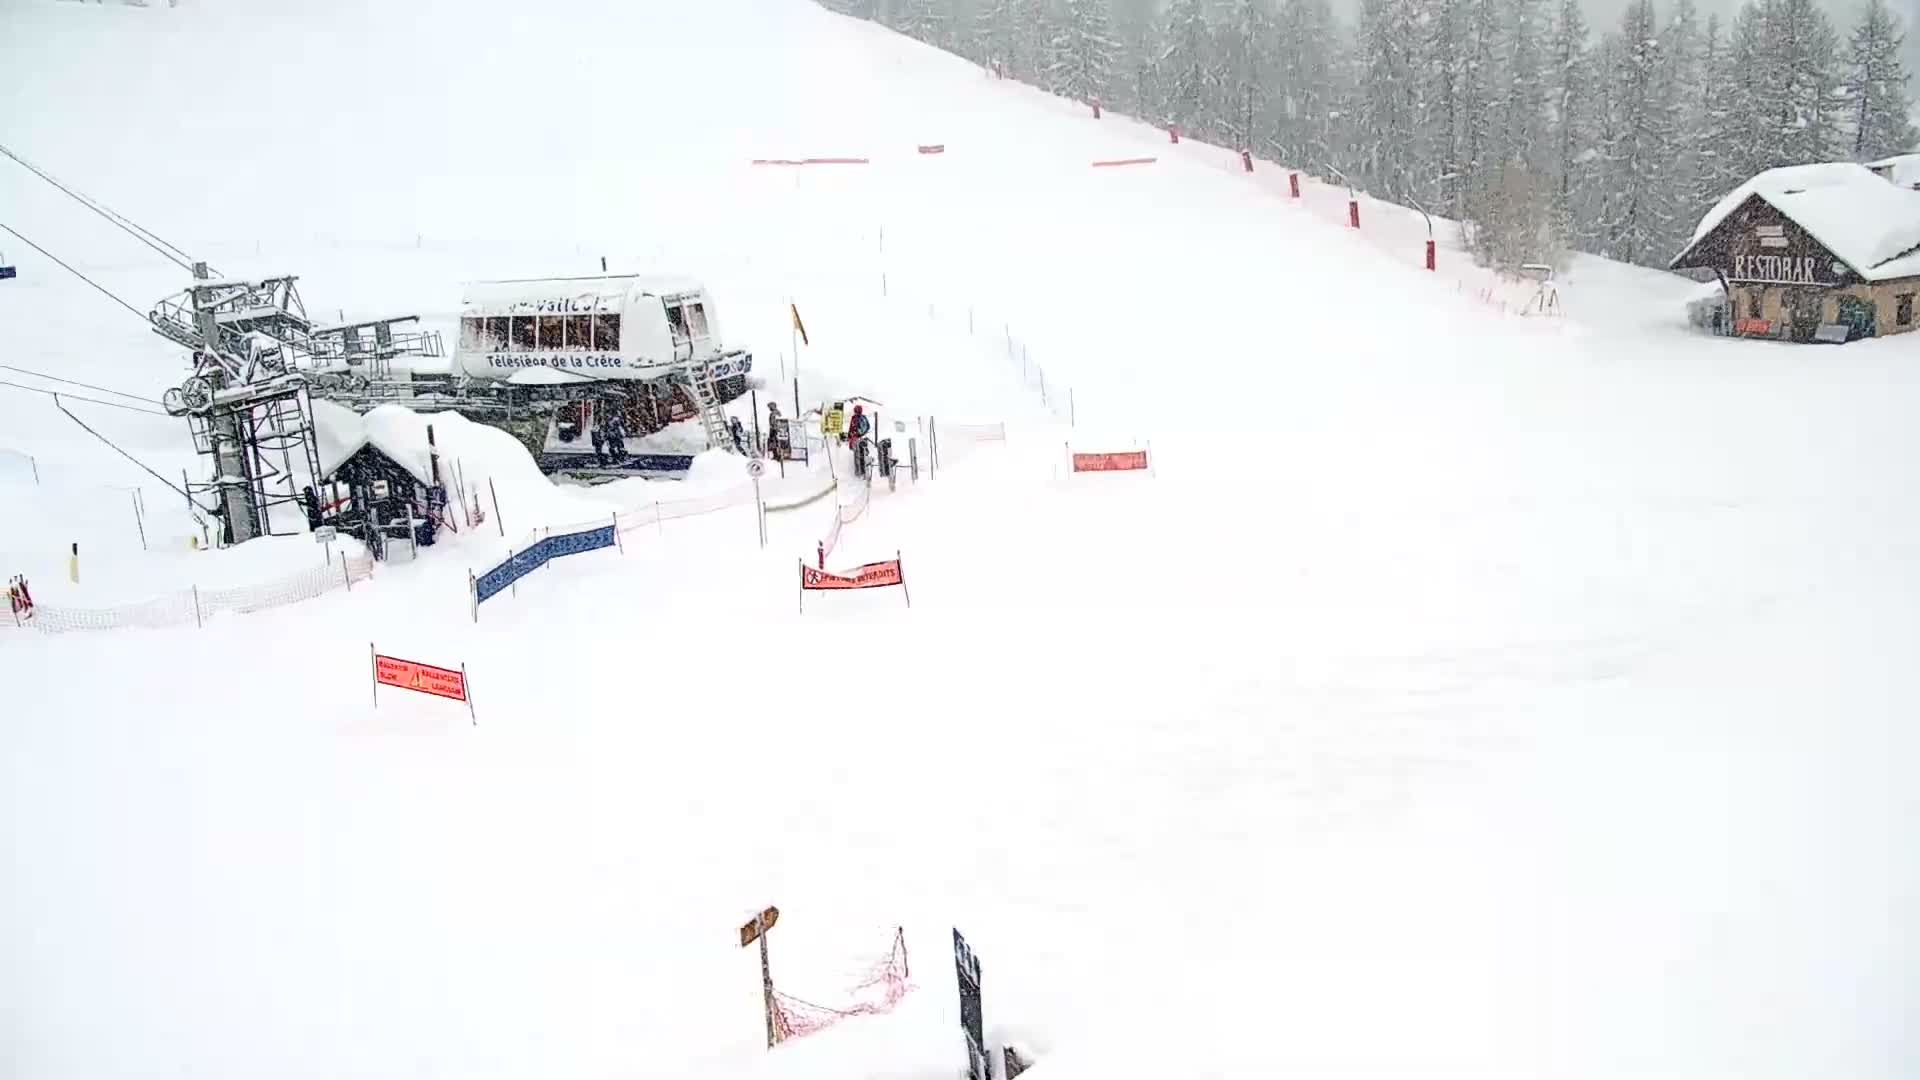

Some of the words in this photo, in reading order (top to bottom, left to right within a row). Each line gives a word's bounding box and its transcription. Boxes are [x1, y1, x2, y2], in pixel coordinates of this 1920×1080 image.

[1735, 255, 1814, 283] RESTOBAR
[551, 355, 566, 368] de
[571, 355, 582, 368] la
